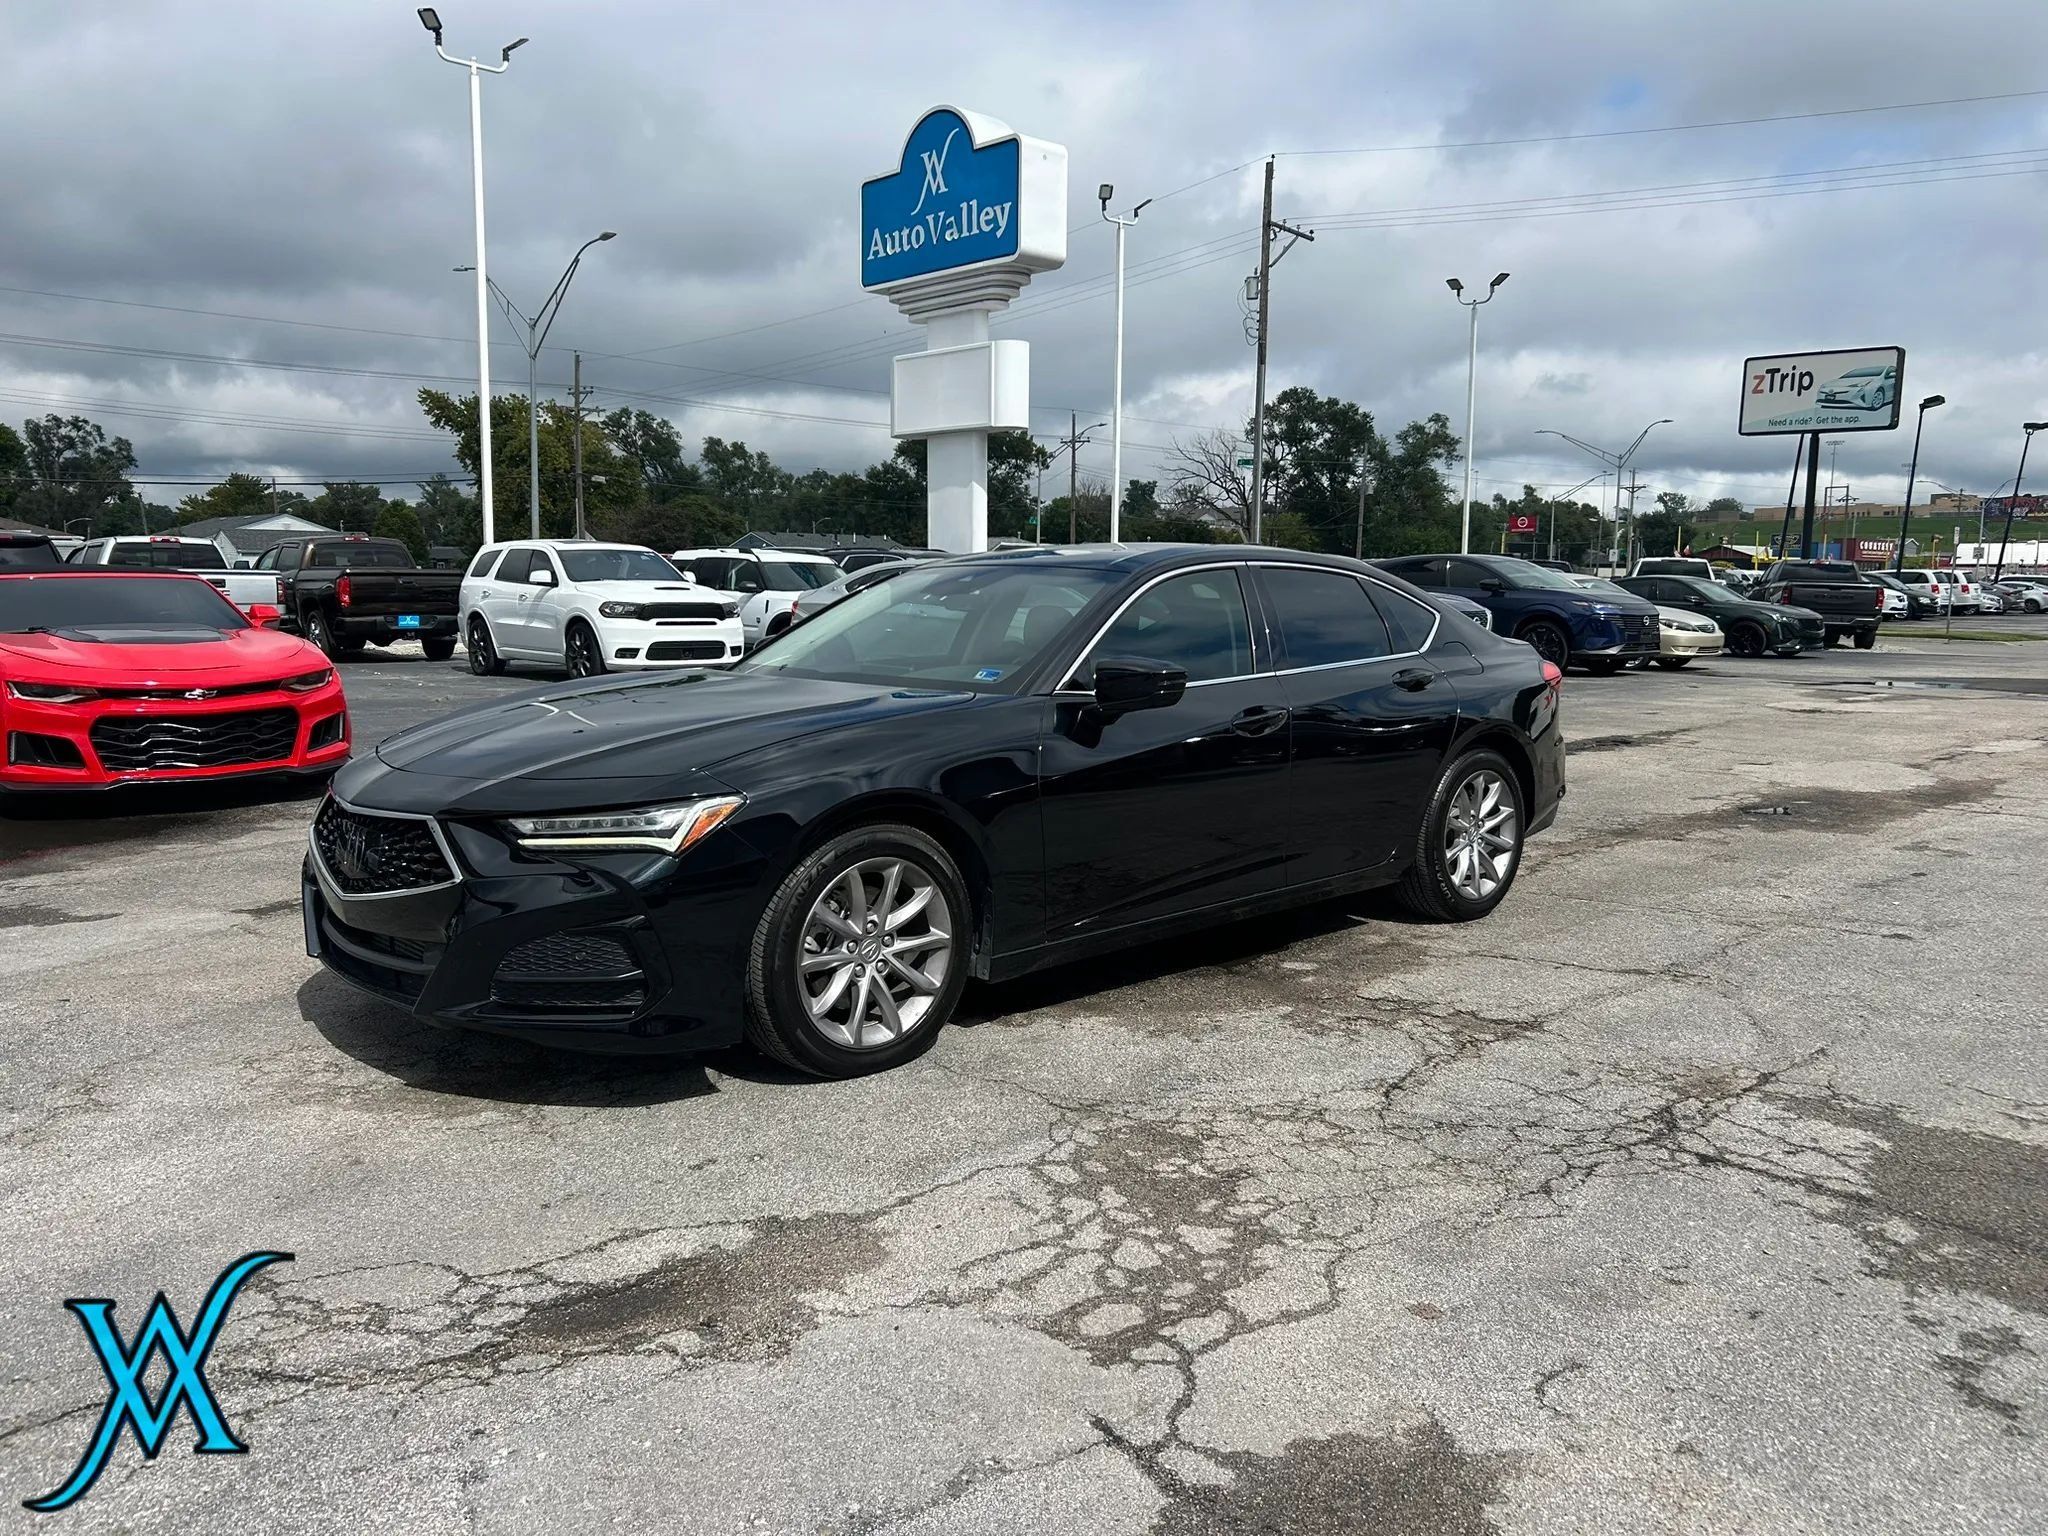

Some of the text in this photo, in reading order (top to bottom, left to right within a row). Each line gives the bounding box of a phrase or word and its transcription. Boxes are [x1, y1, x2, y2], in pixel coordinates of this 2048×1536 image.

[1752, 365, 1814, 397] zTrip
[1768, 418, 1787, 427] Need
[1795, 416, 1813, 426] ride?
[1816, 416, 1829, 425] Get
[1830, 416, 1843, 424] the
[1844, 416, 1862, 425] app.
